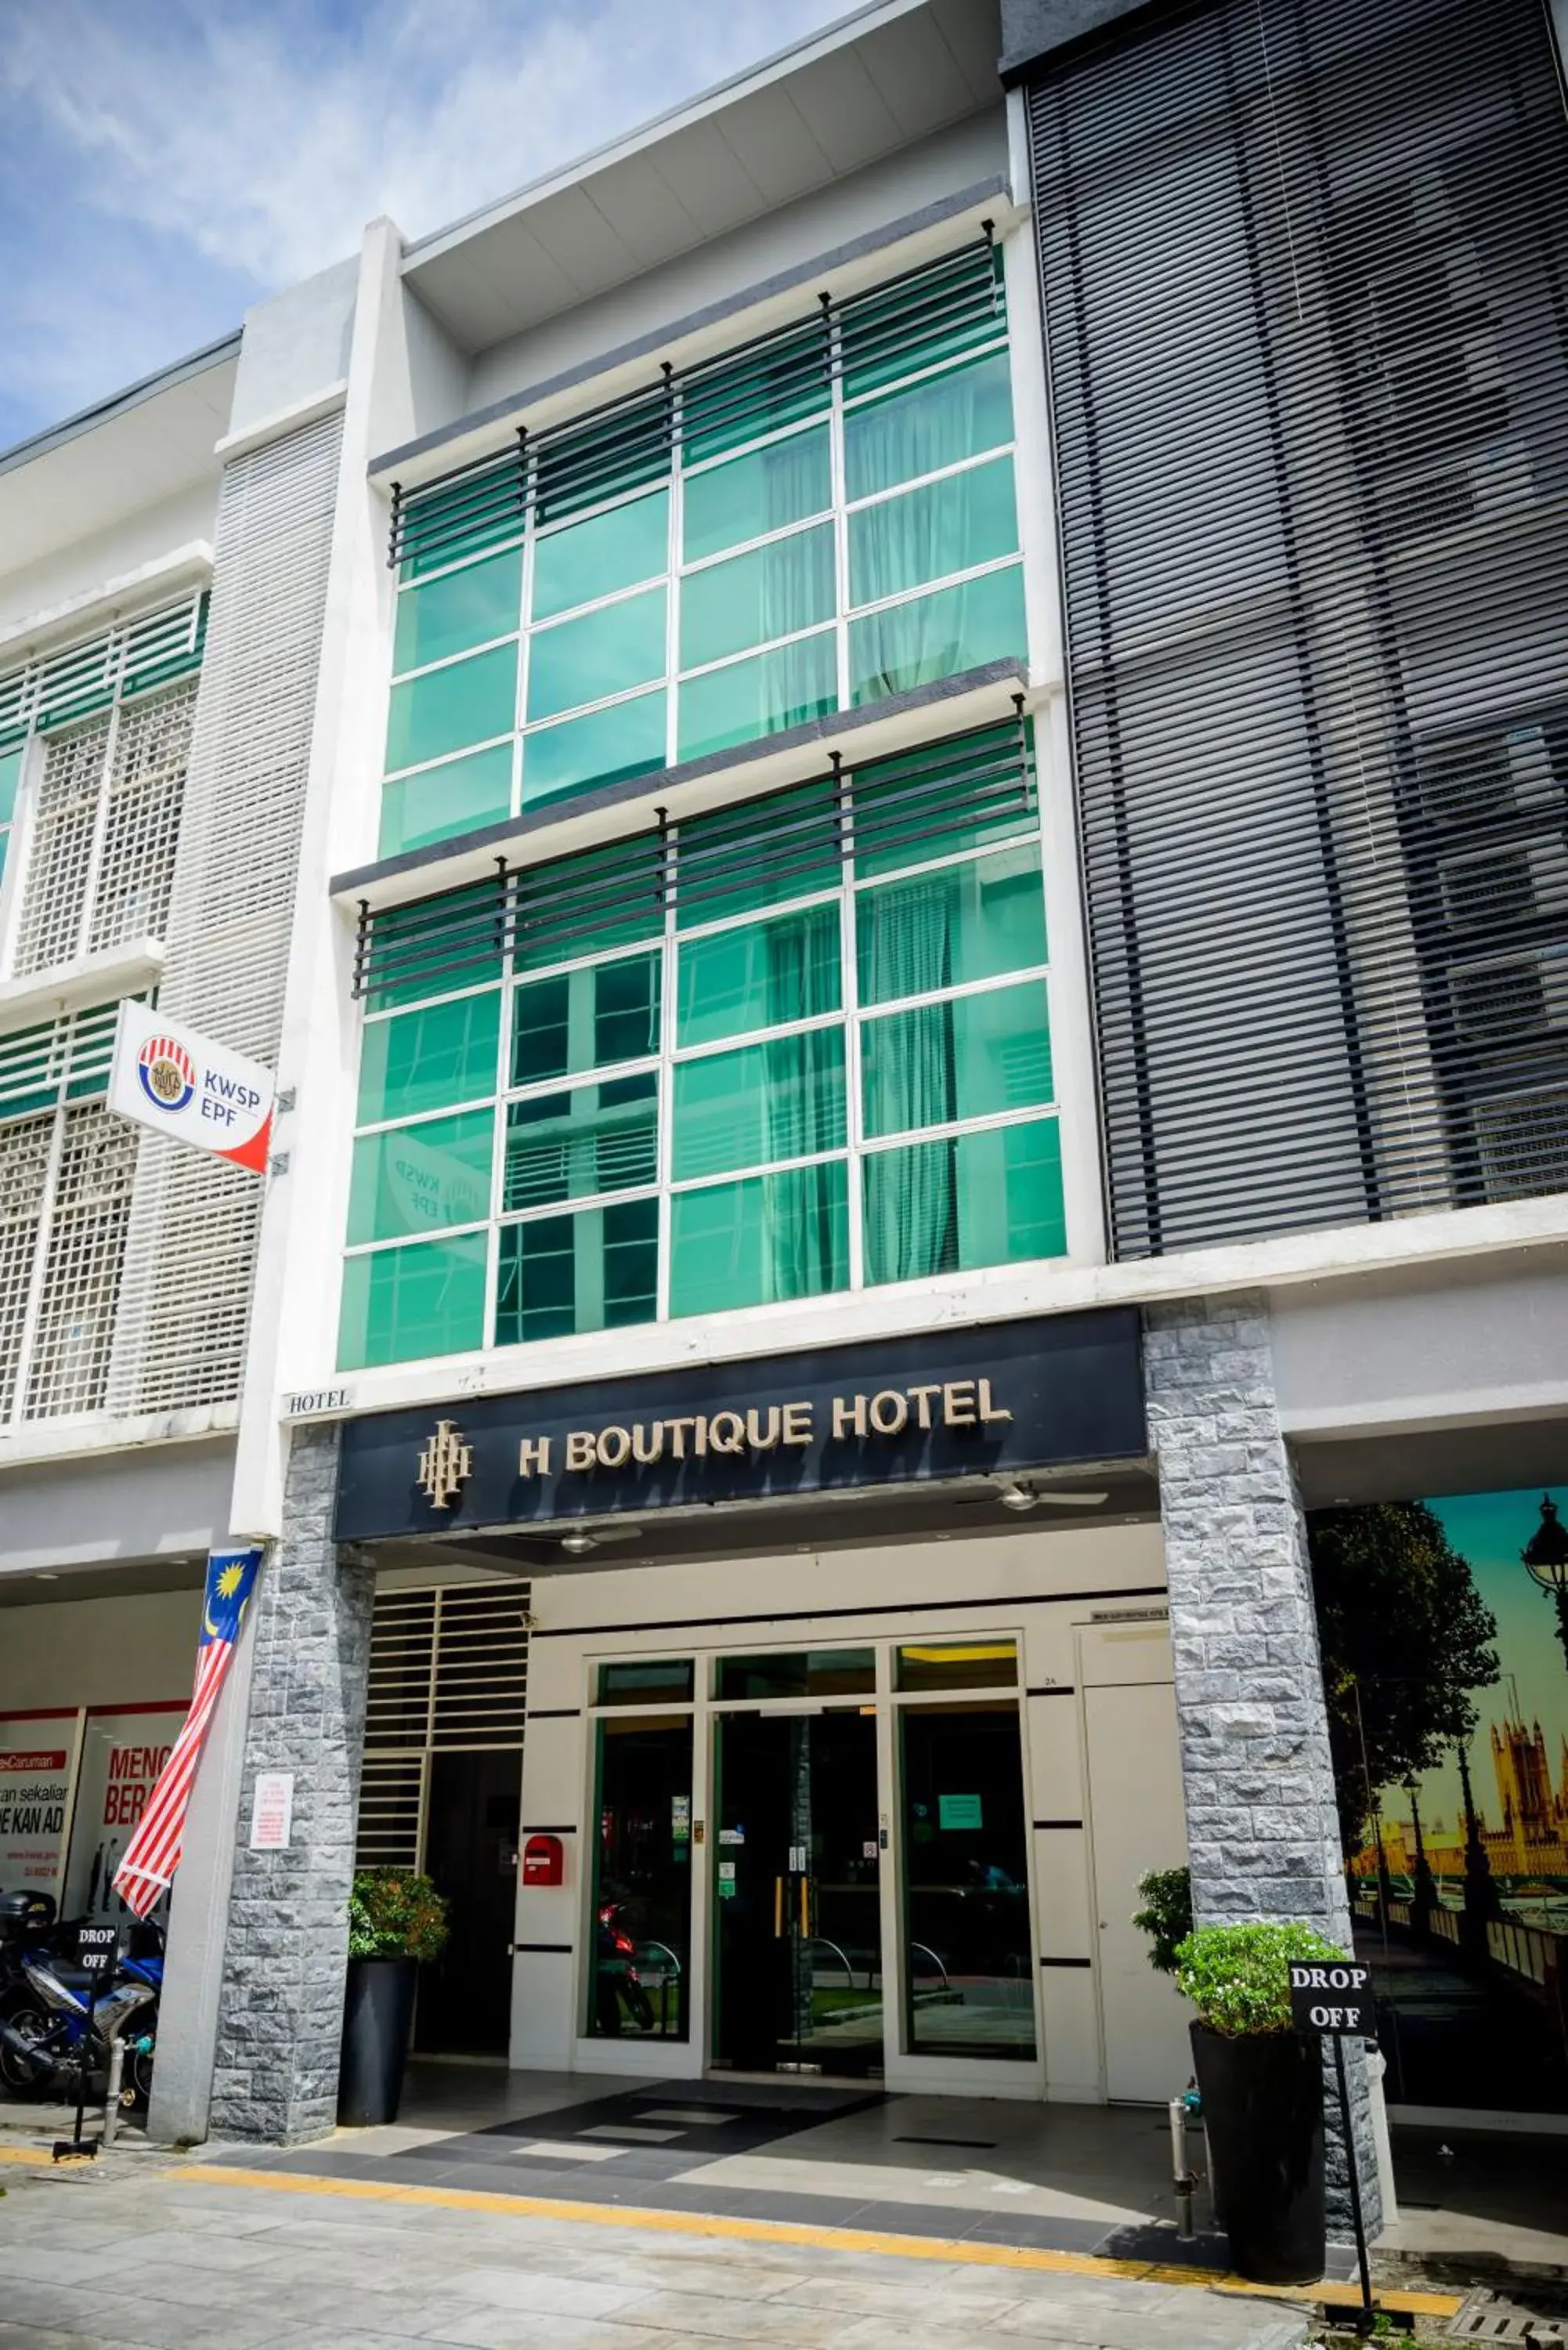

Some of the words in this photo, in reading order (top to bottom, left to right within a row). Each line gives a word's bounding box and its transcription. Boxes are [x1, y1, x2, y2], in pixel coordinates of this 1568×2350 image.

[204, 1069, 260, 1109] KWSP
[201, 1097, 237, 1126] EPF
[289, 1389, 350, 1413] HOTEL
[519, 1436, 552, 1478] H
[565, 1401, 814, 1472] BOUTIQUE
[832, 1378, 1013, 1440] HOTEL
[103, 1783, 156, 1825] BER
[79, 1929, 115, 1943] DROP
[82, 1954, 108, 1969] OFF
[1291, 1968, 1367, 1990] DROP
[1310, 2006, 1360, 2028] OFF
